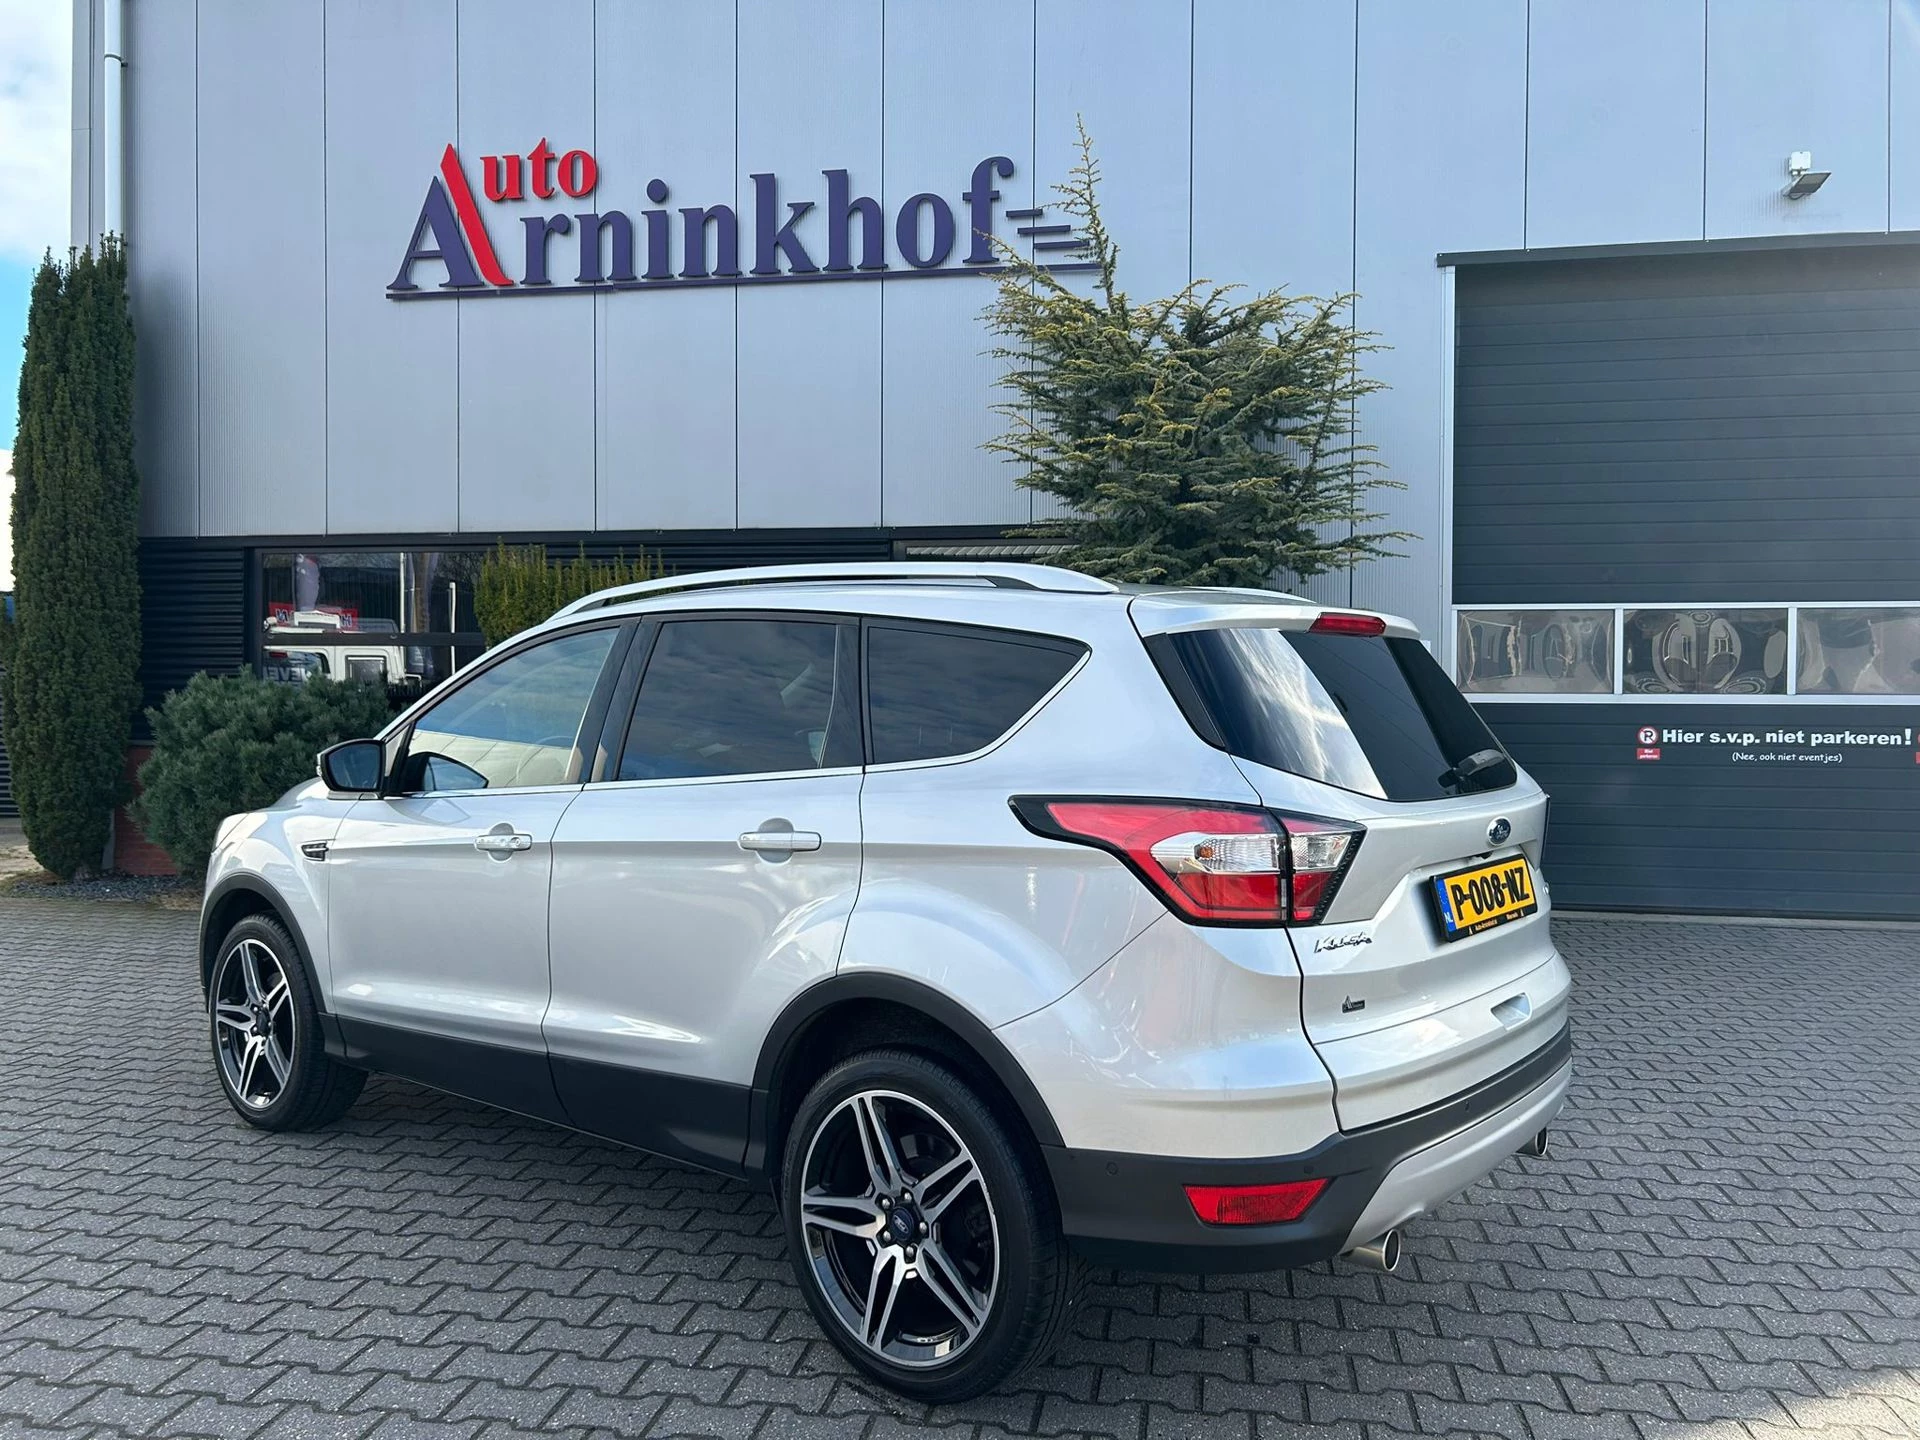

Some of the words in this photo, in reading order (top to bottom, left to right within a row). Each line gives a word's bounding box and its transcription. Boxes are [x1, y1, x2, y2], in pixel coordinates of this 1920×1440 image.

[386, 156, 1014, 290] Arninkhof
[1662, 729, 1704, 743] Hier
[1709, 732, 1760, 746] s.v.p.
[1765, 730, 1805, 743] niet
[1810, 728, 1911, 746] parkeren!
[1732, 752, 1757, 762] (Nee,
[1759, 753, 1776, 761] ook
[1777, 753, 1796, 761] niet
[1798, 753, 1843, 763] eventjes)
[1450, 866, 1530, 921] P-008-NZ
